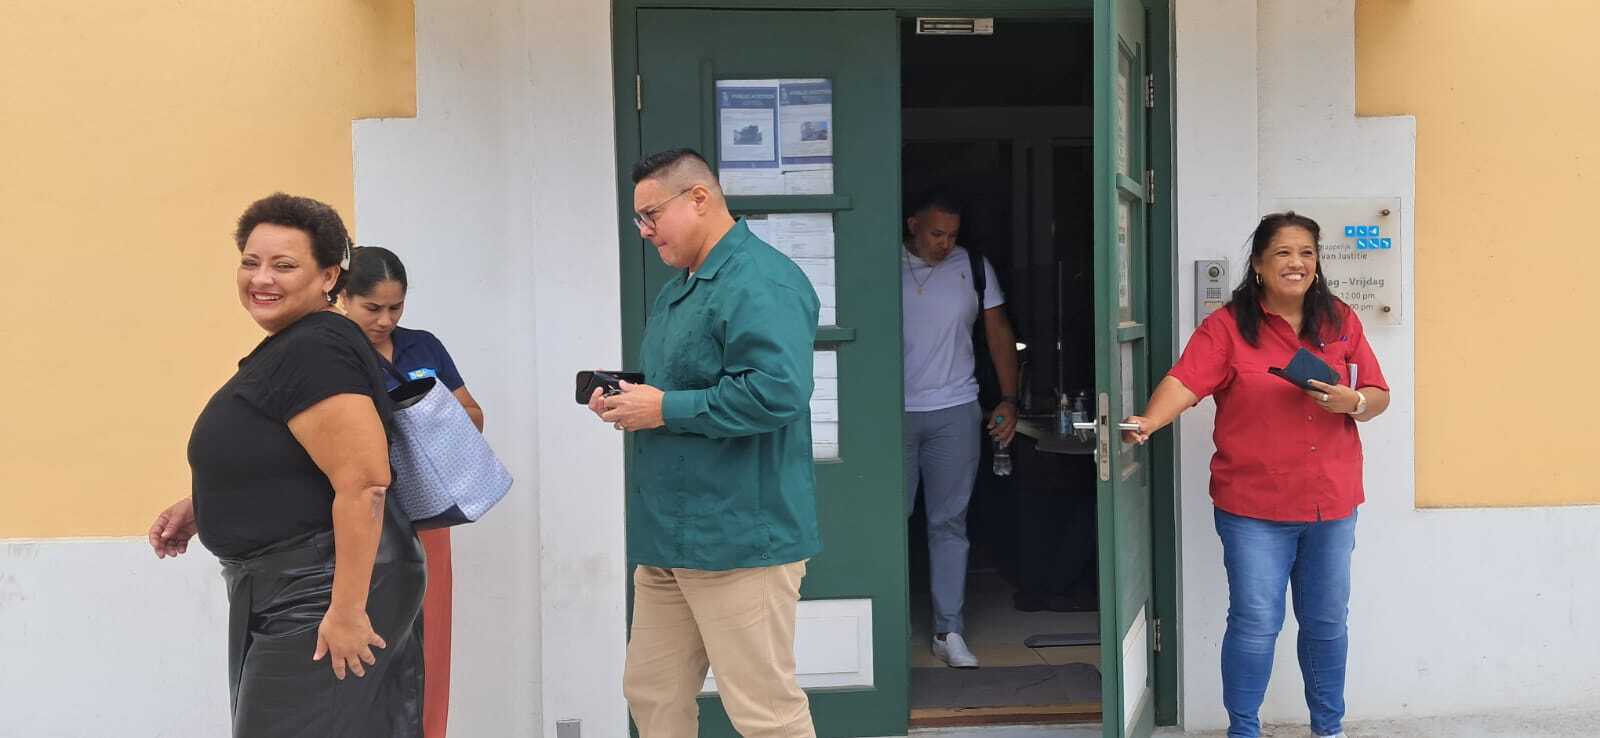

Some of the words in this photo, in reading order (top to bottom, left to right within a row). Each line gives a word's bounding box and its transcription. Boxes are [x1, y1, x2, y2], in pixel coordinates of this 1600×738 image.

[1339, 252, 1368, 260] Justitie
[1349, 277, 1384, 287] Vrijdag
[1363, 292, 1376, 300] pm
[1361, 304, 1374, 312] pm
